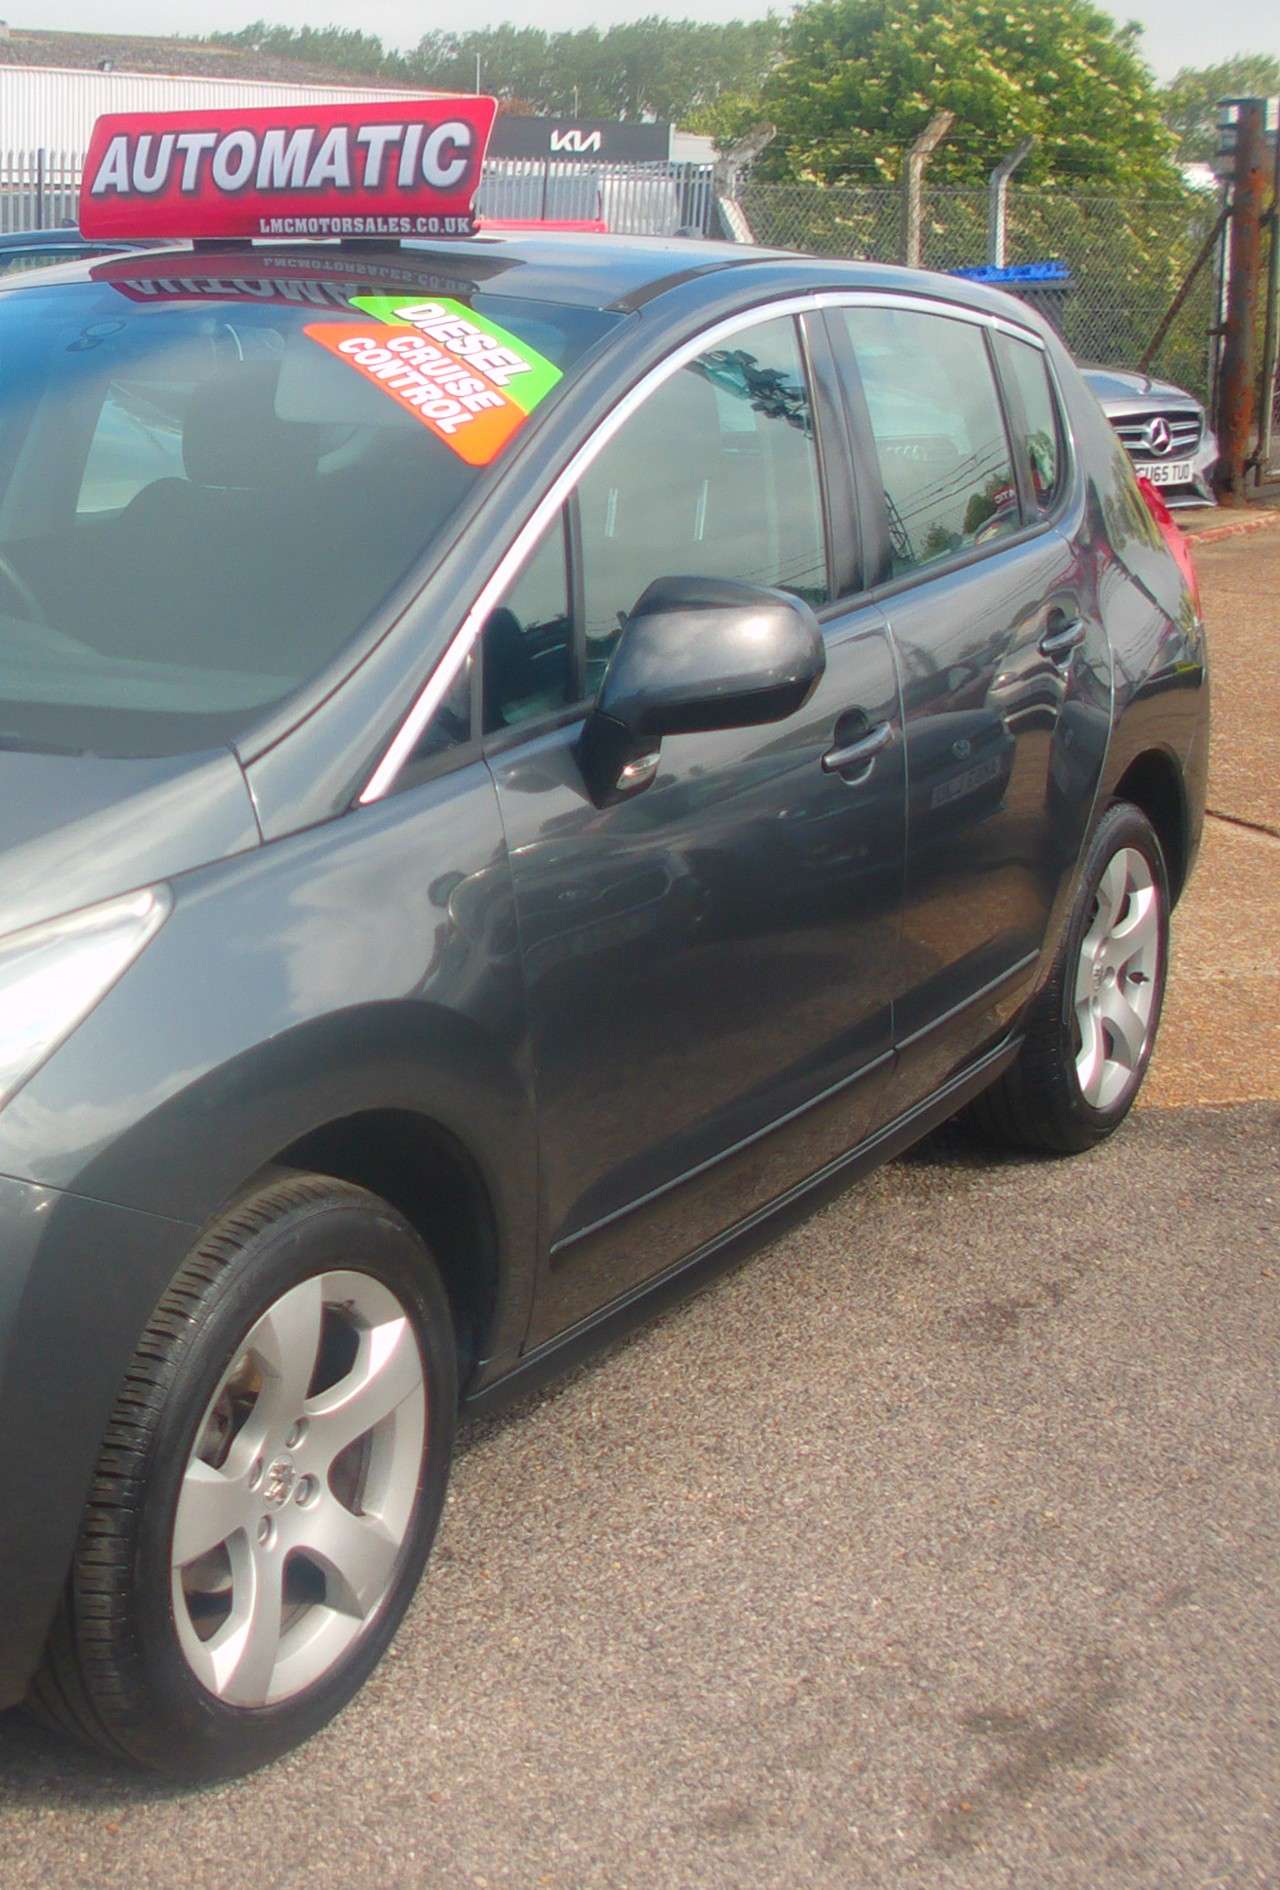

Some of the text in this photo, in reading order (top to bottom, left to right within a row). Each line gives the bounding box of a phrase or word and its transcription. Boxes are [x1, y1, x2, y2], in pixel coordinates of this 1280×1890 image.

[91, 122, 472, 194] AUTOMATIC
[550, 129, 601, 152] KIA
[260, 216, 472, 234] LMCMOTORSALES.CO.UK
[386, 335, 506, 412] CRUISE
[392, 302, 533, 386] DIESEL
[337, 337, 475, 434] CONTROL
